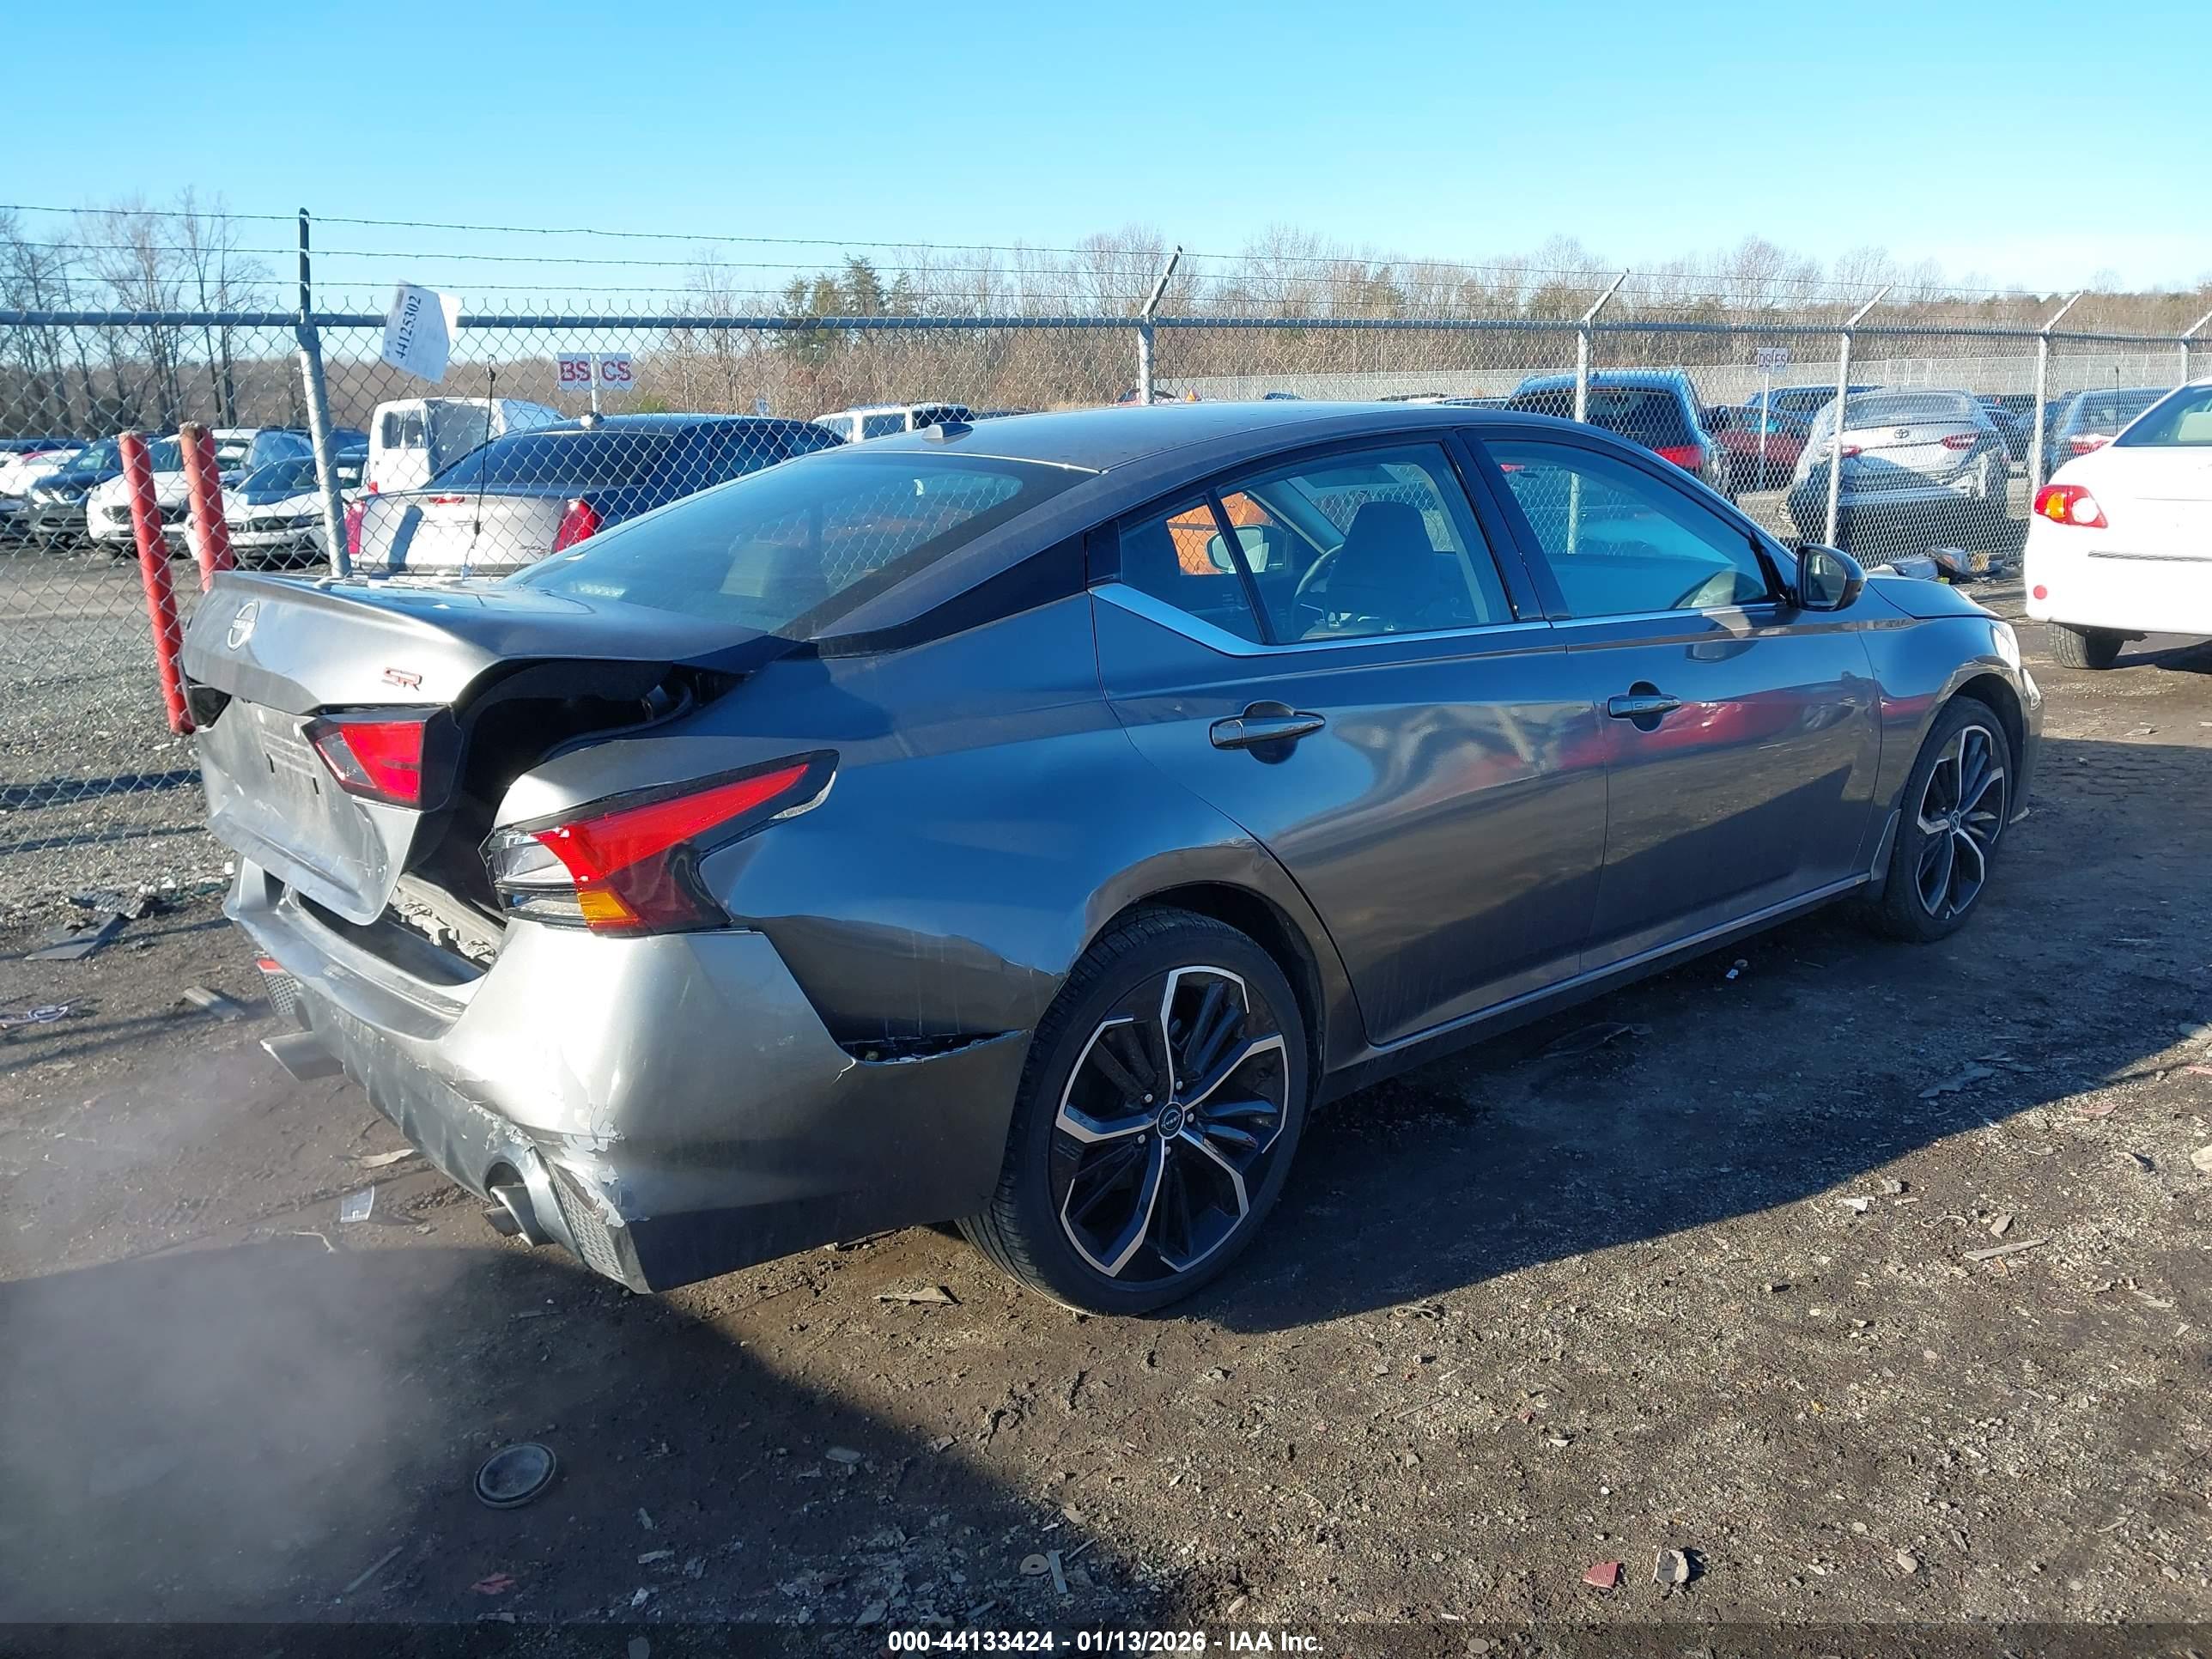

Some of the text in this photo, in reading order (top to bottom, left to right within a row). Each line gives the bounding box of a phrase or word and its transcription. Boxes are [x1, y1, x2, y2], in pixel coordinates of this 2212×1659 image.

[395, 295, 422, 359] 44125302
[560, 361, 592, 381] BS
[601, 361, 632, 381] CS
